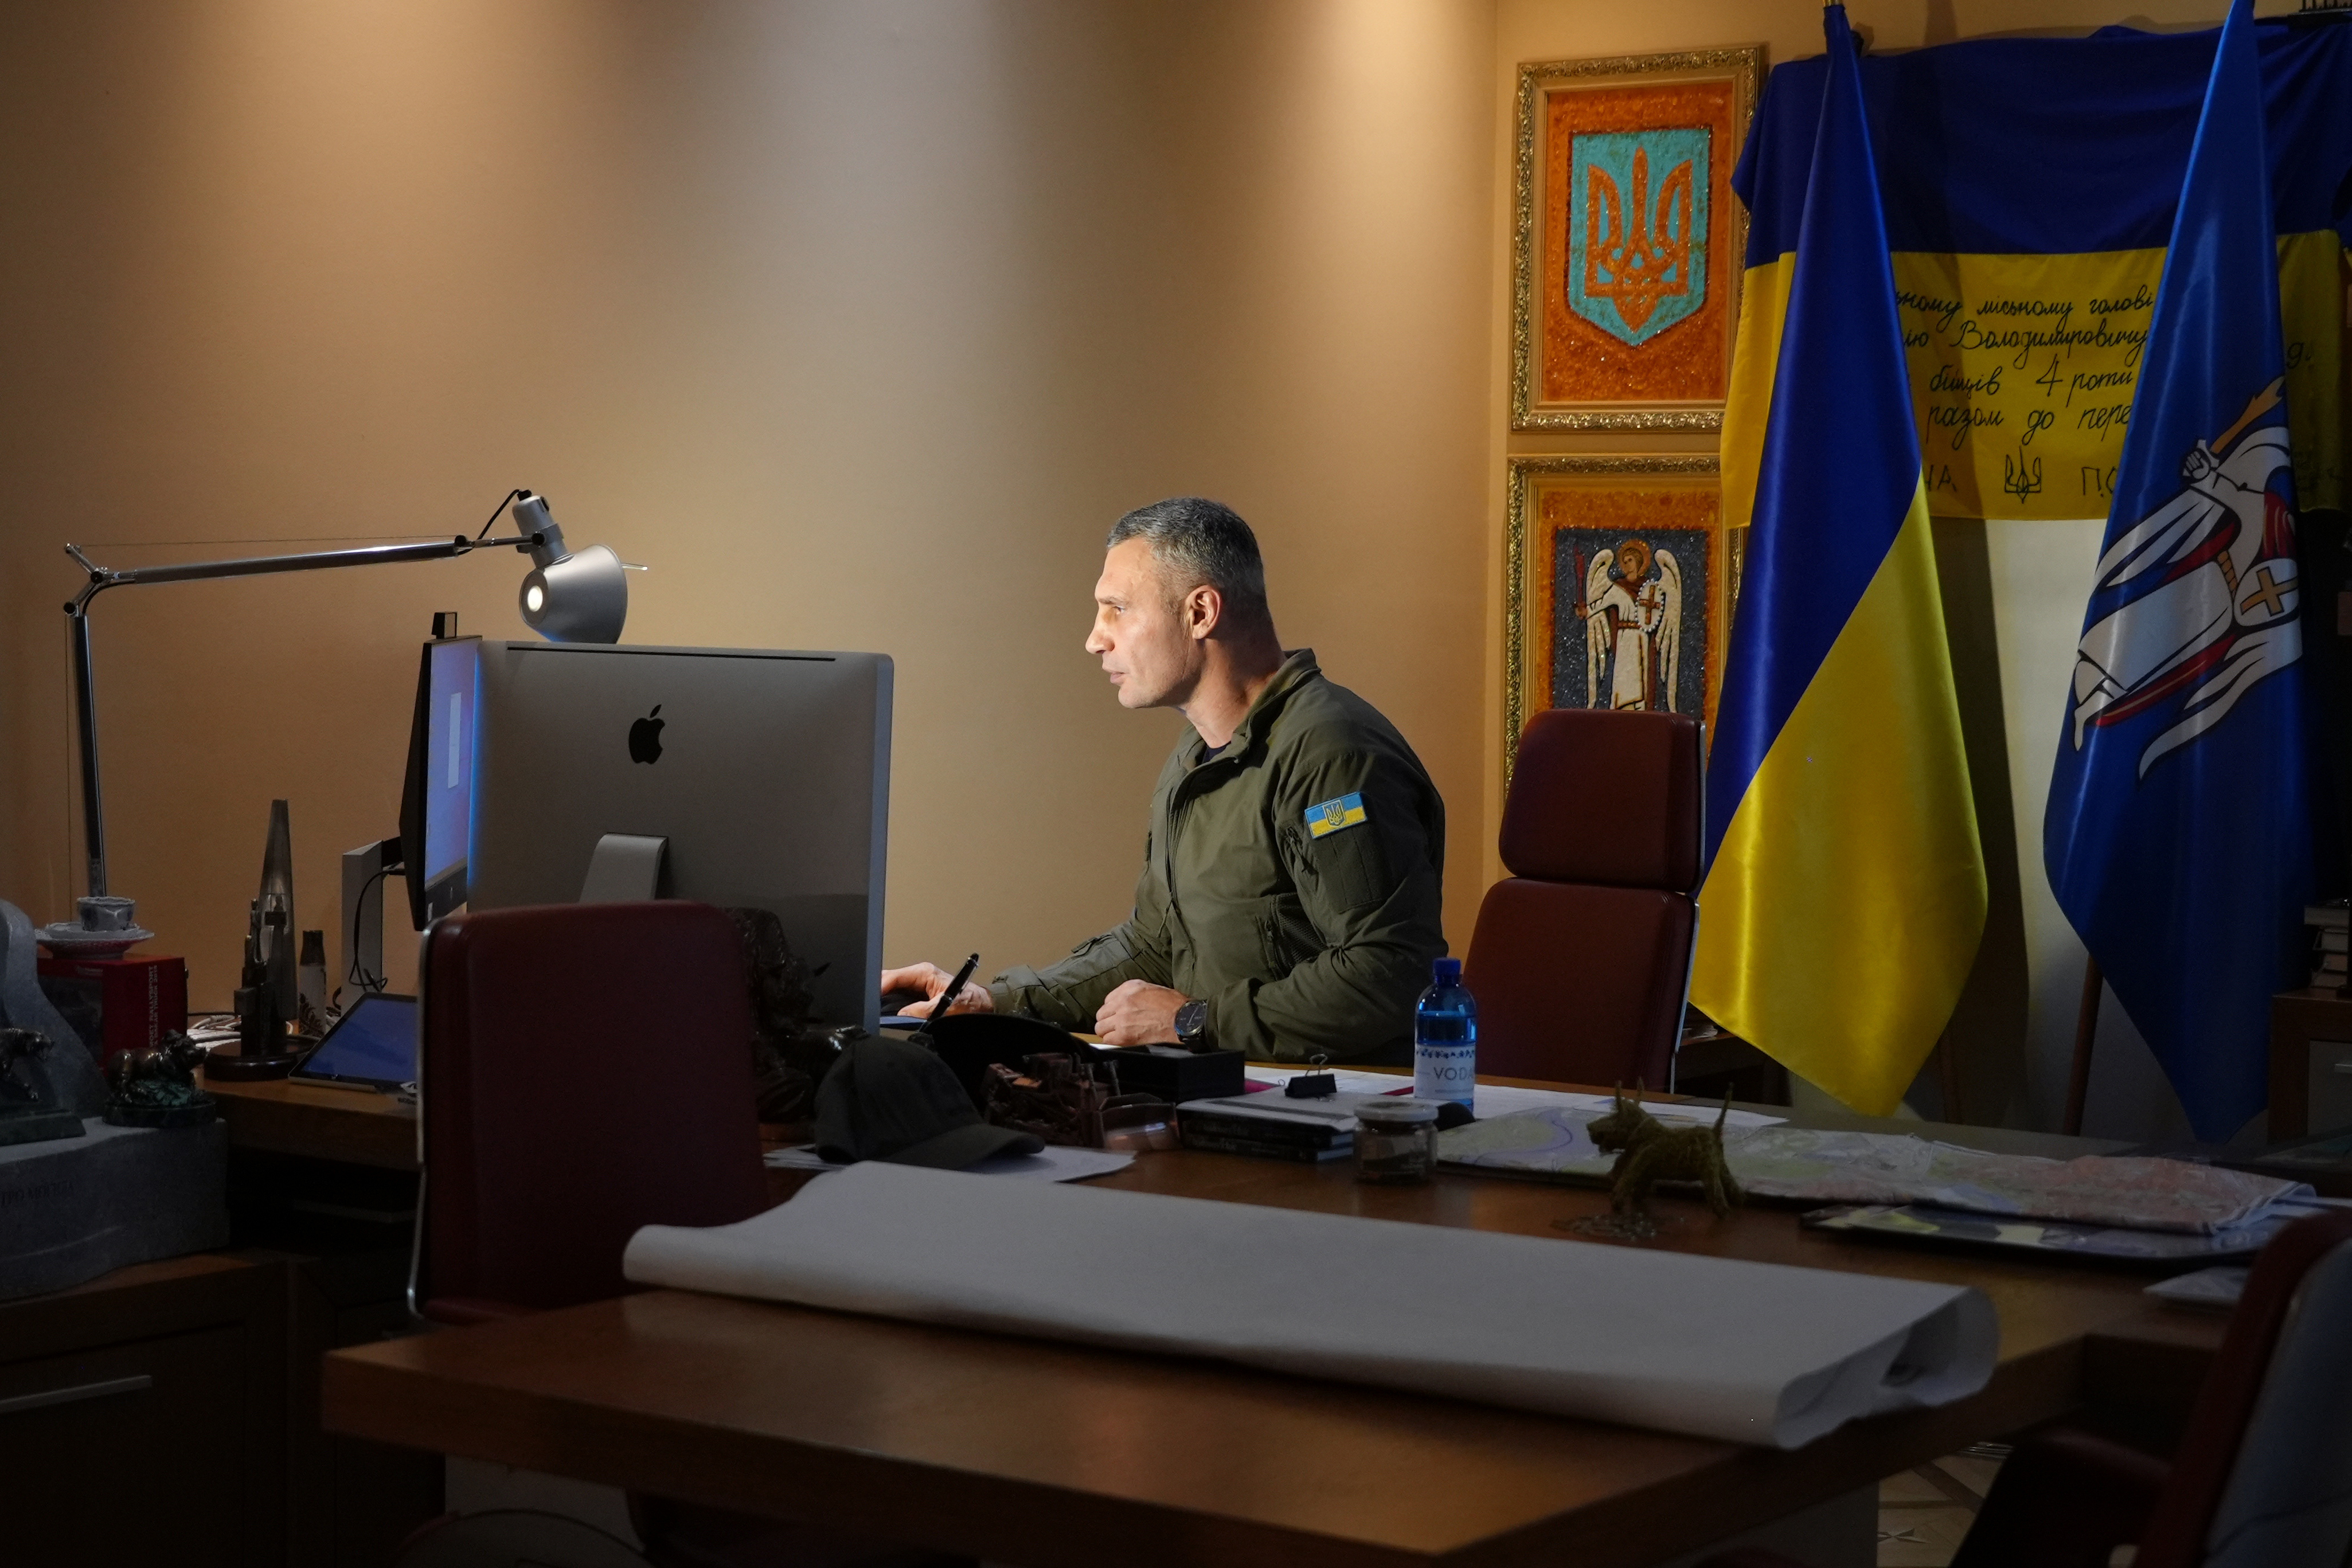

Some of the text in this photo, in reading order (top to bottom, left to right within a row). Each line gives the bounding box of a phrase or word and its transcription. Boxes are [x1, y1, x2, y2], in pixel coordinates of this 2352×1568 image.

[2089, 284, 2154, 314] голові
[1949, 318, 2148, 370] Володимировичу
[2036, 353, 2064, 397] 4
[2065, 372, 2134, 408] роти
[1926, 404, 2131, 451] разом до пере
